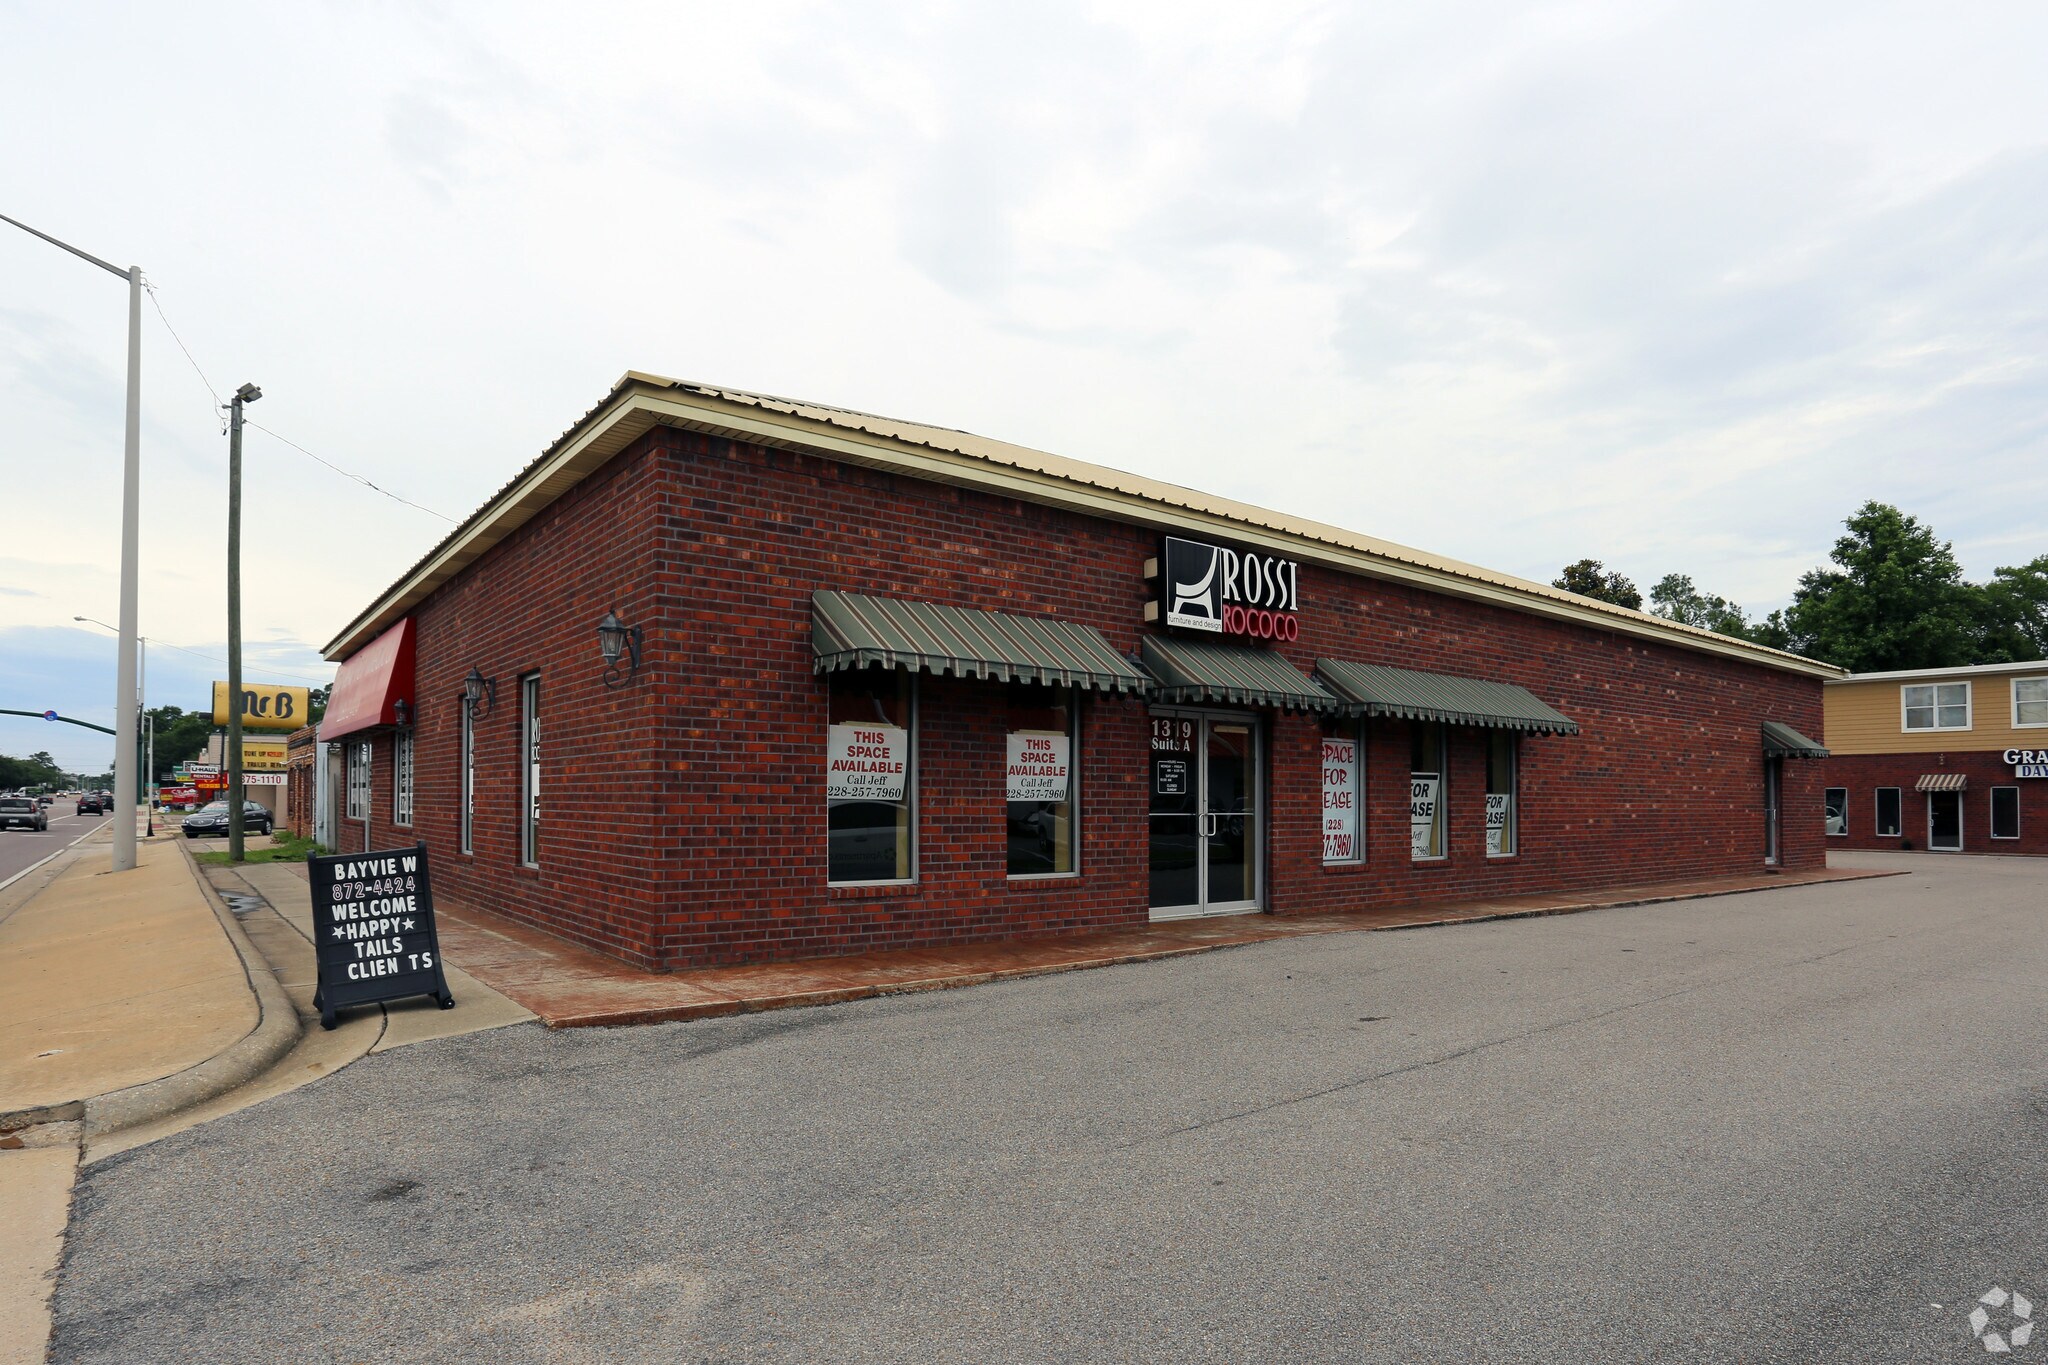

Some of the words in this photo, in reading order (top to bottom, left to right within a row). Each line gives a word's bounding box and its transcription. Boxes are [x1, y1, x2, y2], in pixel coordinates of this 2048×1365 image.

[1222, 548, 1298, 611] ROSSI
[1168, 614, 1191, 625] furniture
[1192, 619, 1203, 627] and
[1204, 621, 1221, 630] design
[1223, 604, 1298, 642] ROCOCO
[275, 692, 294, 719] B
[854, 731, 884, 744] THIS
[1026, 739, 1051, 750] THIS
[847, 745, 890, 759] SPACE
[1183, 739, 1191, 751] A
[1021, 752, 1056, 763] SPACE
[831, 760, 903, 774] AVAILABLE
[1008, 765, 1066, 777] AVAILABLE
[847, 775, 866, 785] Call
[868, 775, 888, 785] Jeff
[1020, 778, 1036, 787] Call
[1037, 778, 1054, 787] Jeff
[1324, 768, 1347, 785] FOR
[828, 786, 901, 798] 228-257-7960
[1006, 789, 1065, 799] 228-257-7960
[1411, 783, 1429, 797] OR
[1486, 796, 1503, 808] FOR
[1326, 819, 1344, 830] (228)
[332, 875, 416, 900] 872-4424
[332, 895, 417, 921] WELCOME
[346, 917, 401, 939] HAPPY
[354, 937, 403, 958] TAILS
